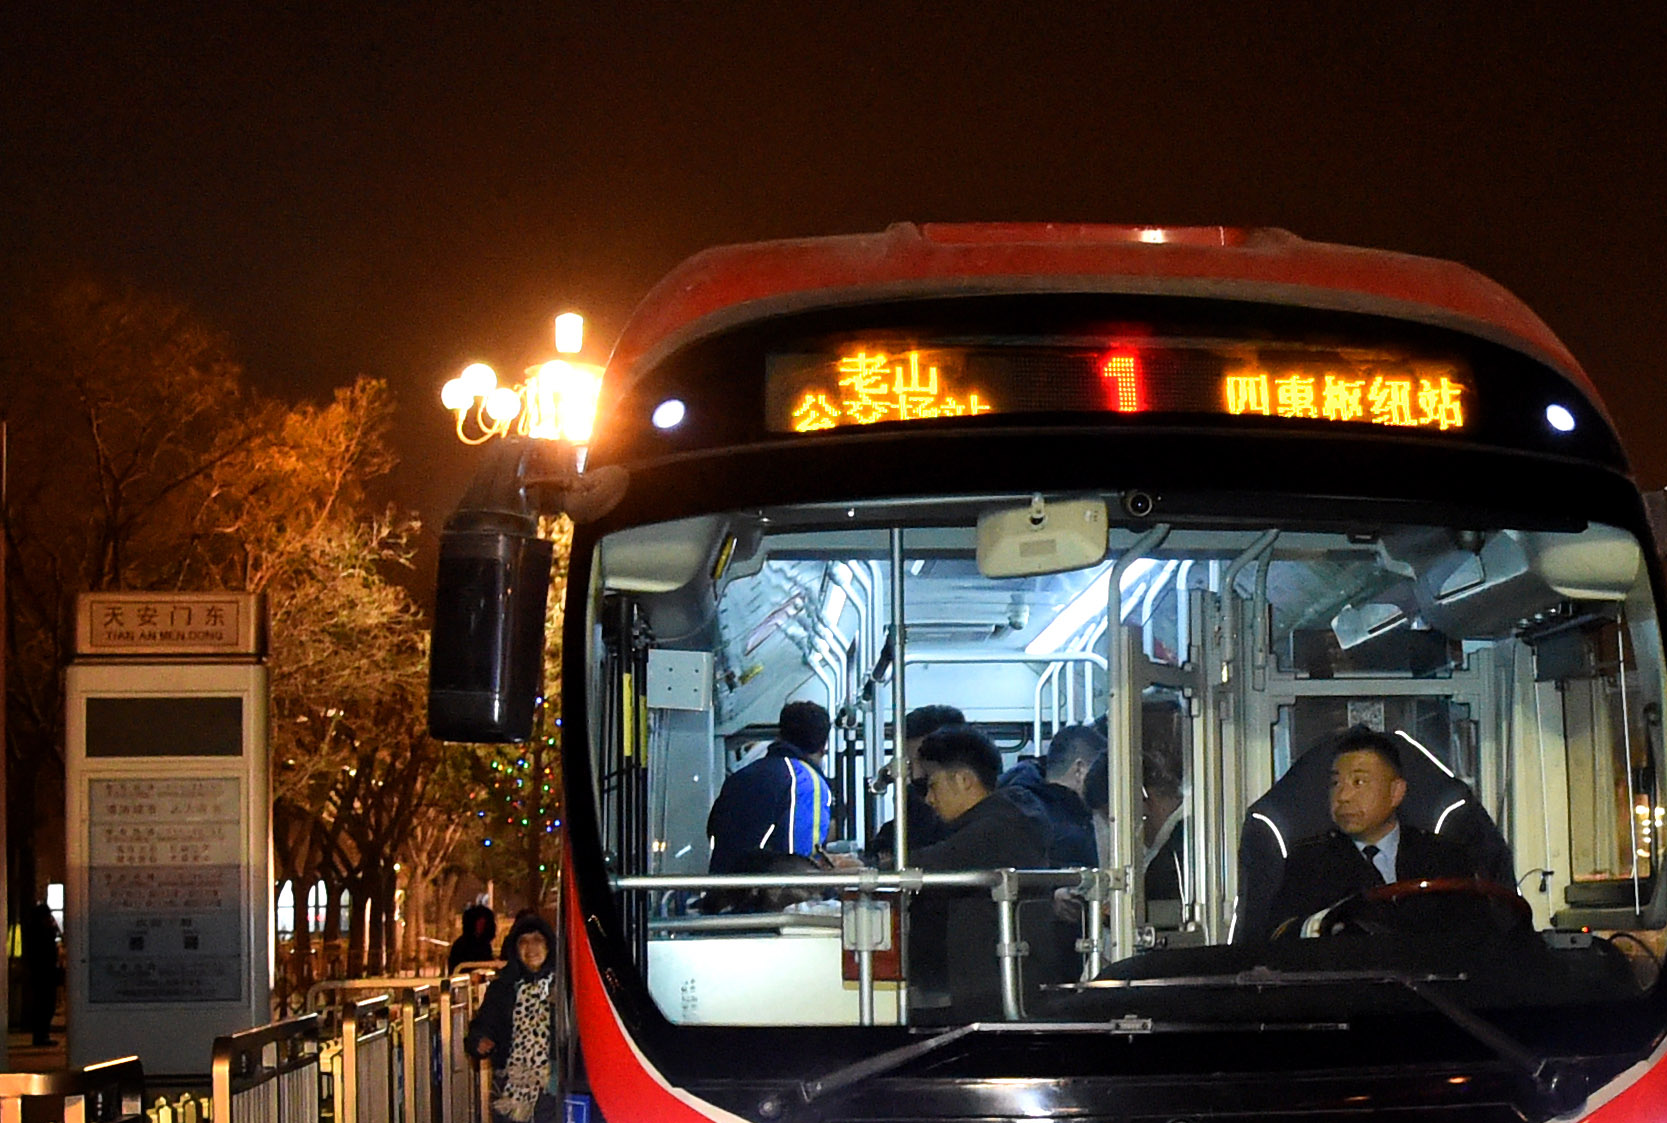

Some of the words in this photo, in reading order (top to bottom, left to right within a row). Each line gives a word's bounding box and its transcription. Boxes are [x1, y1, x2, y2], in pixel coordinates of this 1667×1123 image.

[838, 352, 938, 394] 老山
[1103, 356, 1137, 412] 1
[1225, 374, 1463, 430] 四惠枢纽站
[104, 605, 225, 628] 天安门东
[106, 630, 135, 641] TIAN
[140, 630, 157, 641] AN
[160, 630, 185, 641] MEN
[188, 630, 223, 641] DONG
